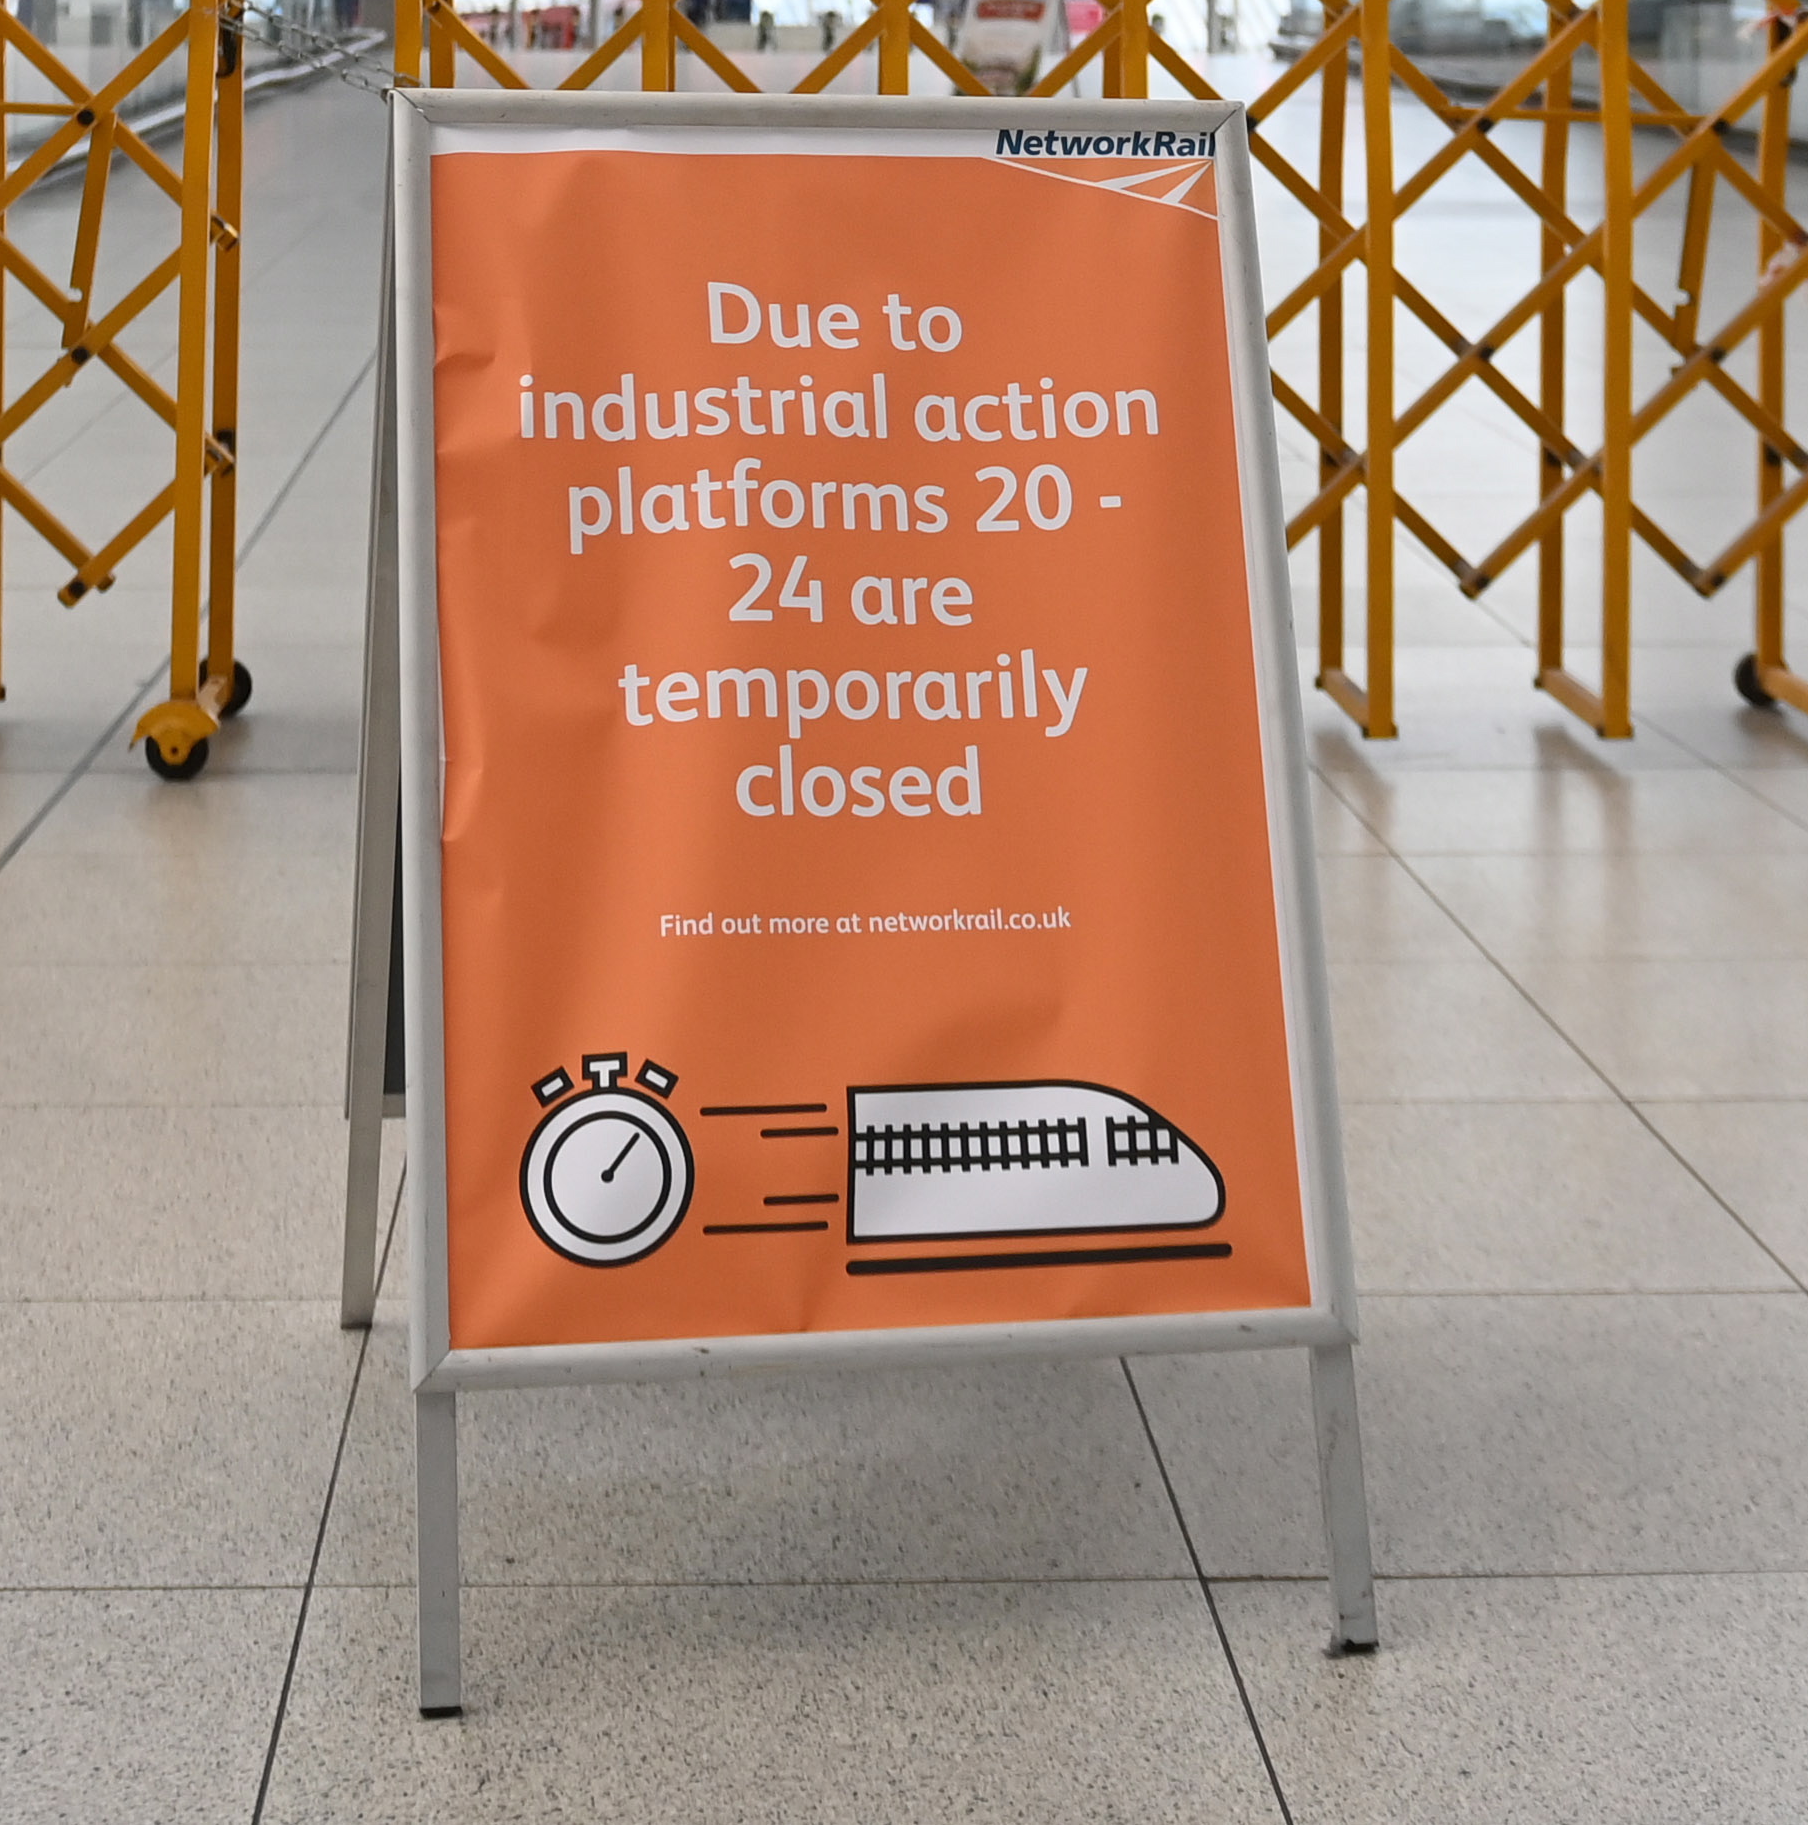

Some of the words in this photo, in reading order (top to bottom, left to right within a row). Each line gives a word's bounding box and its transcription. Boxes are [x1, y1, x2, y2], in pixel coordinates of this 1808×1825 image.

[995, 128, 1216, 157] NetworkRail
[707, 281, 860, 350] Due
[882, 293, 963, 353] to
[519, 372, 888, 442] industrial
[914, 377, 1159, 442] action
[568, 457, 949, 555] platforms
[975, 464, 1073, 532] 20
[1099, 495, 1122, 509] -
[728, 552, 824, 623] 24
[851, 576, 973, 626] are
[618, 648, 1088, 739] temporarily
[736, 744, 982, 817] closed
[660, 912, 714, 938] Find
[721, 914, 762, 935] out
[769, 917, 830, 934] more
[836, 913, 863, 934] at
[869, 905, 1072, 933] networkrail.co.uk
